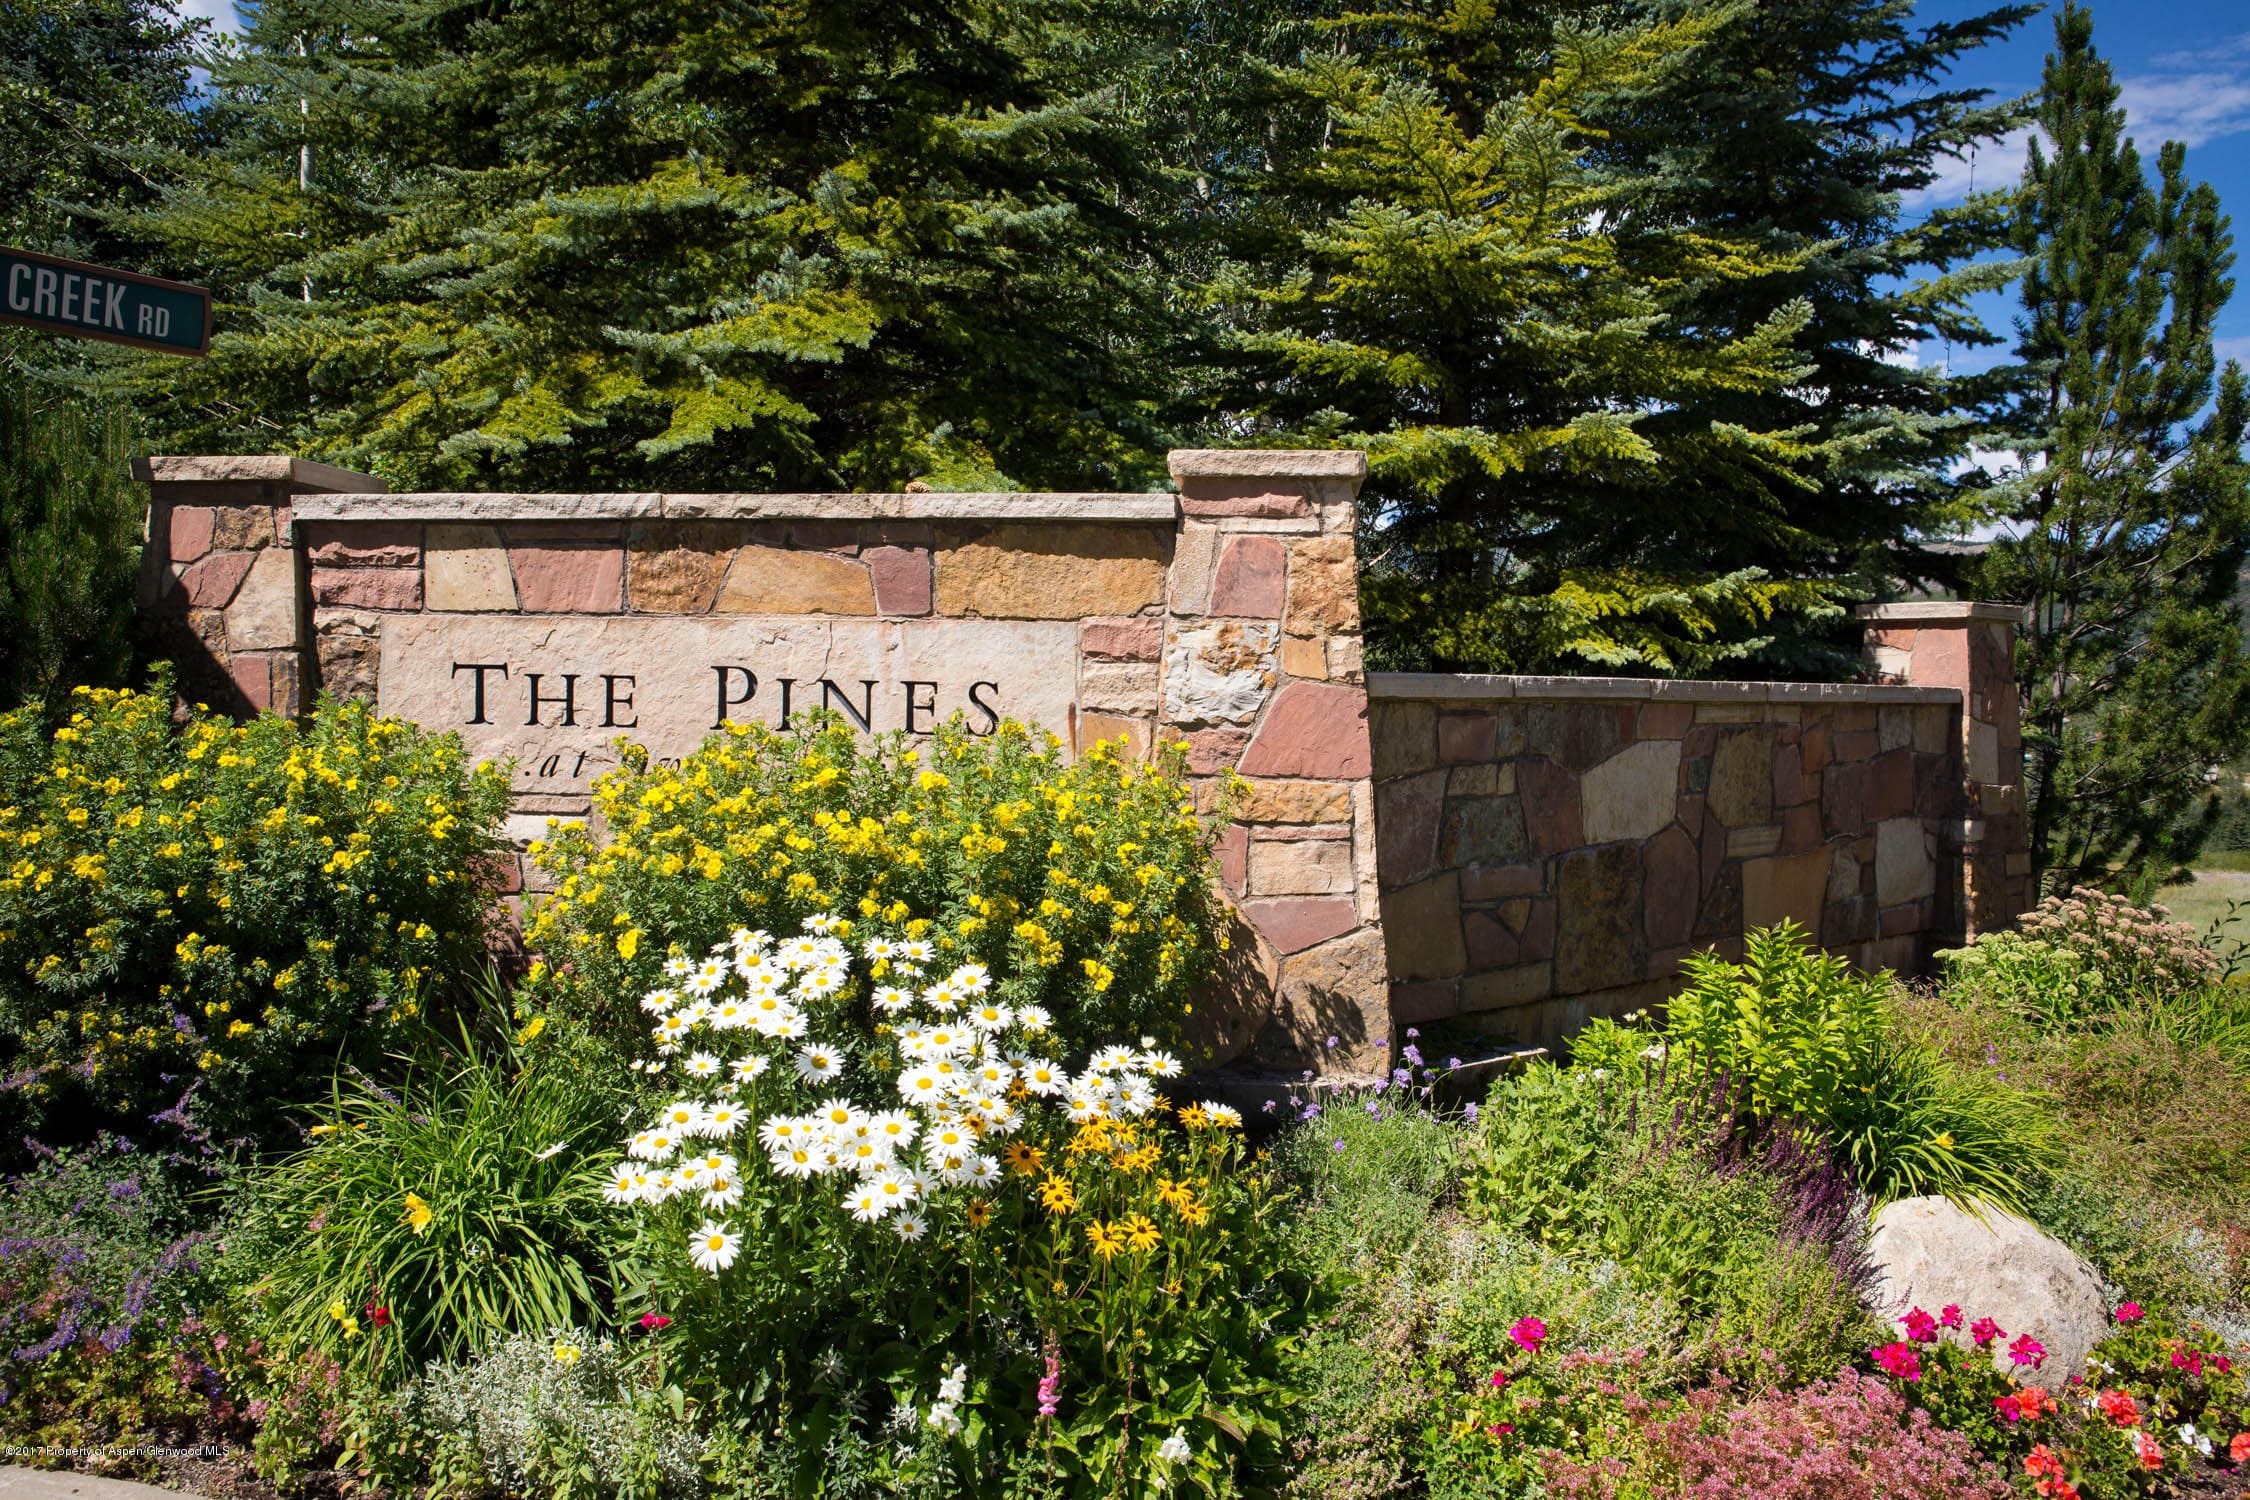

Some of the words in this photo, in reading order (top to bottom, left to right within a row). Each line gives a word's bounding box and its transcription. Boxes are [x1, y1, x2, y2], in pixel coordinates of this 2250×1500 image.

[8, 263, 128, 331] CREEK
[137, 303, 170, 338] RD
[451, 661, 639, 729] THE
[708, 664, 1000, 738] PINES
